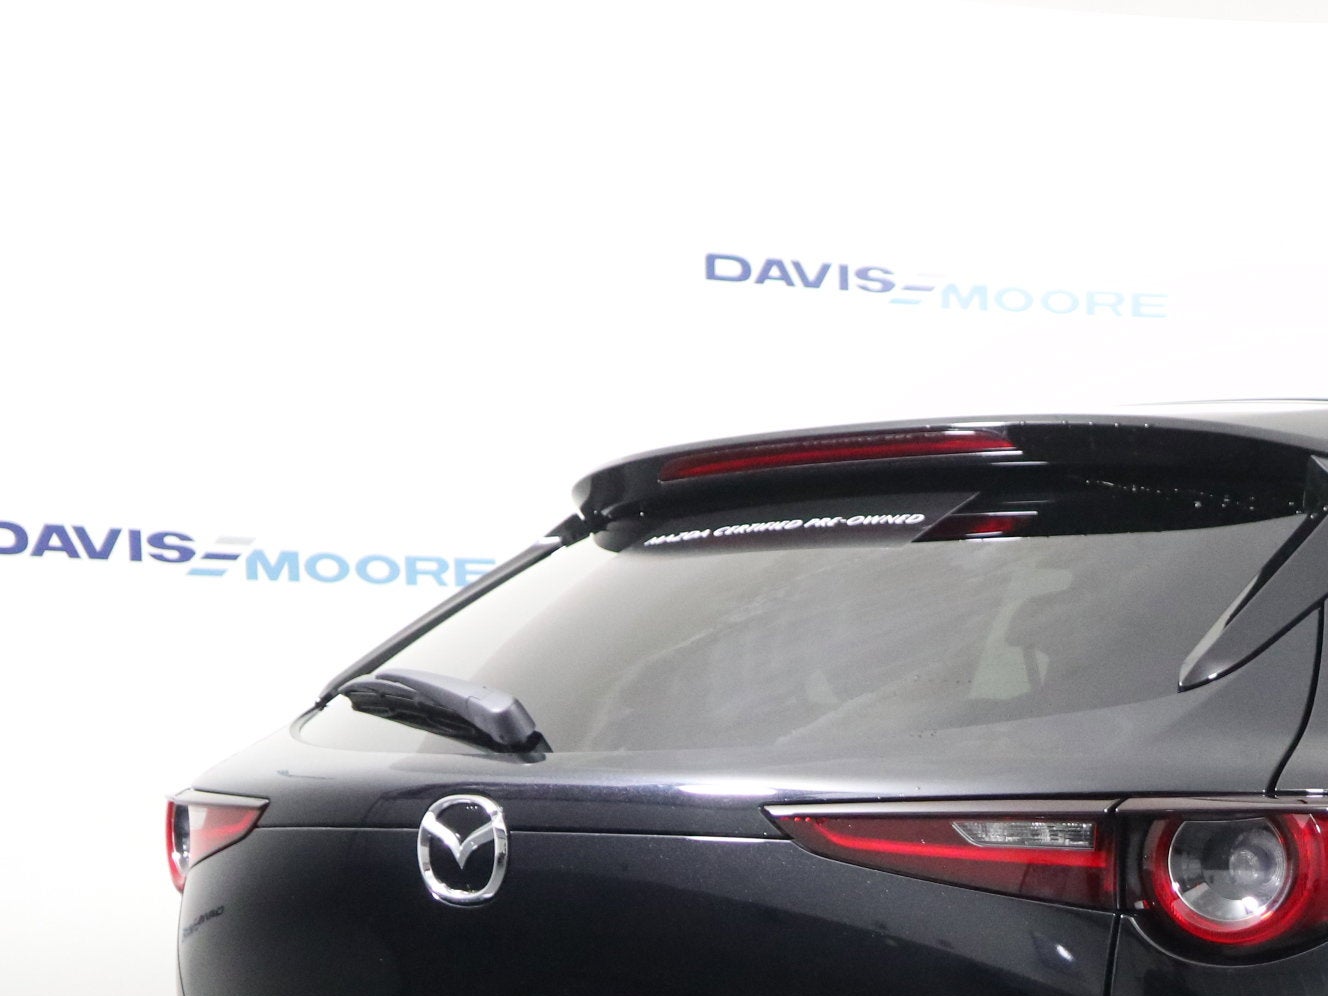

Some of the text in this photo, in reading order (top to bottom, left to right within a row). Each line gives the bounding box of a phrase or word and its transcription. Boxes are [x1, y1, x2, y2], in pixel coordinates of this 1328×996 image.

[643, 513, 926, 546] MAZDA CERTIFIED PRE-OWNED
